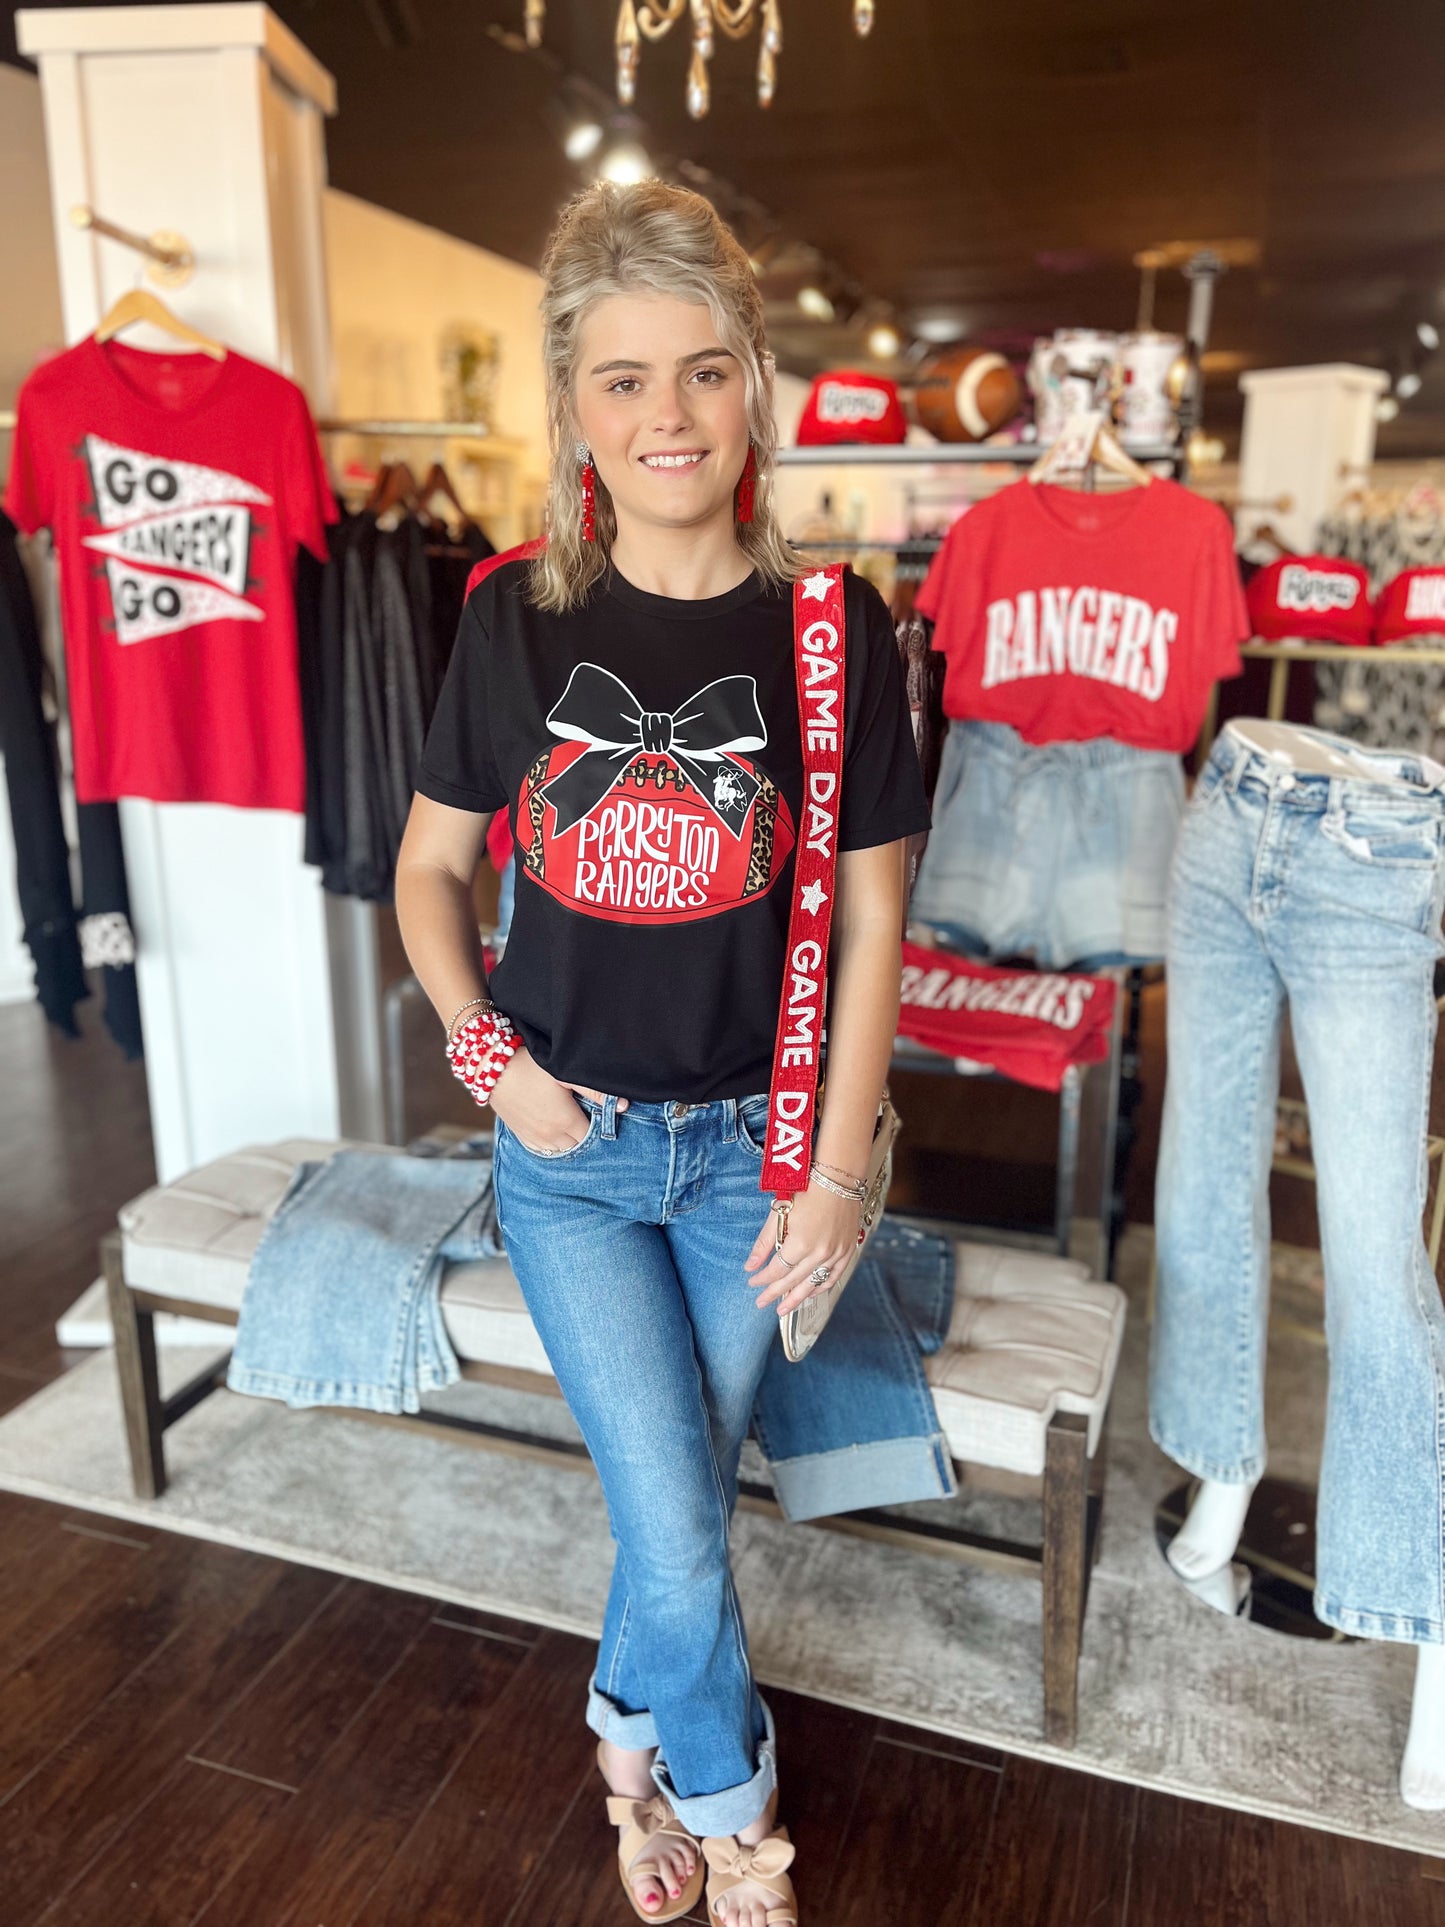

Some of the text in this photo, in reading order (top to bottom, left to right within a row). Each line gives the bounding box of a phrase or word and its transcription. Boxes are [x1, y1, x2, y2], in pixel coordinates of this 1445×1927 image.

[105, 460, 179, 504] GO
[117, 579, 181, 621] GO
[981, 585, 1179, 702] RANGERS
[772, 620, 838, 1171] GAME DAY GAME DAY
